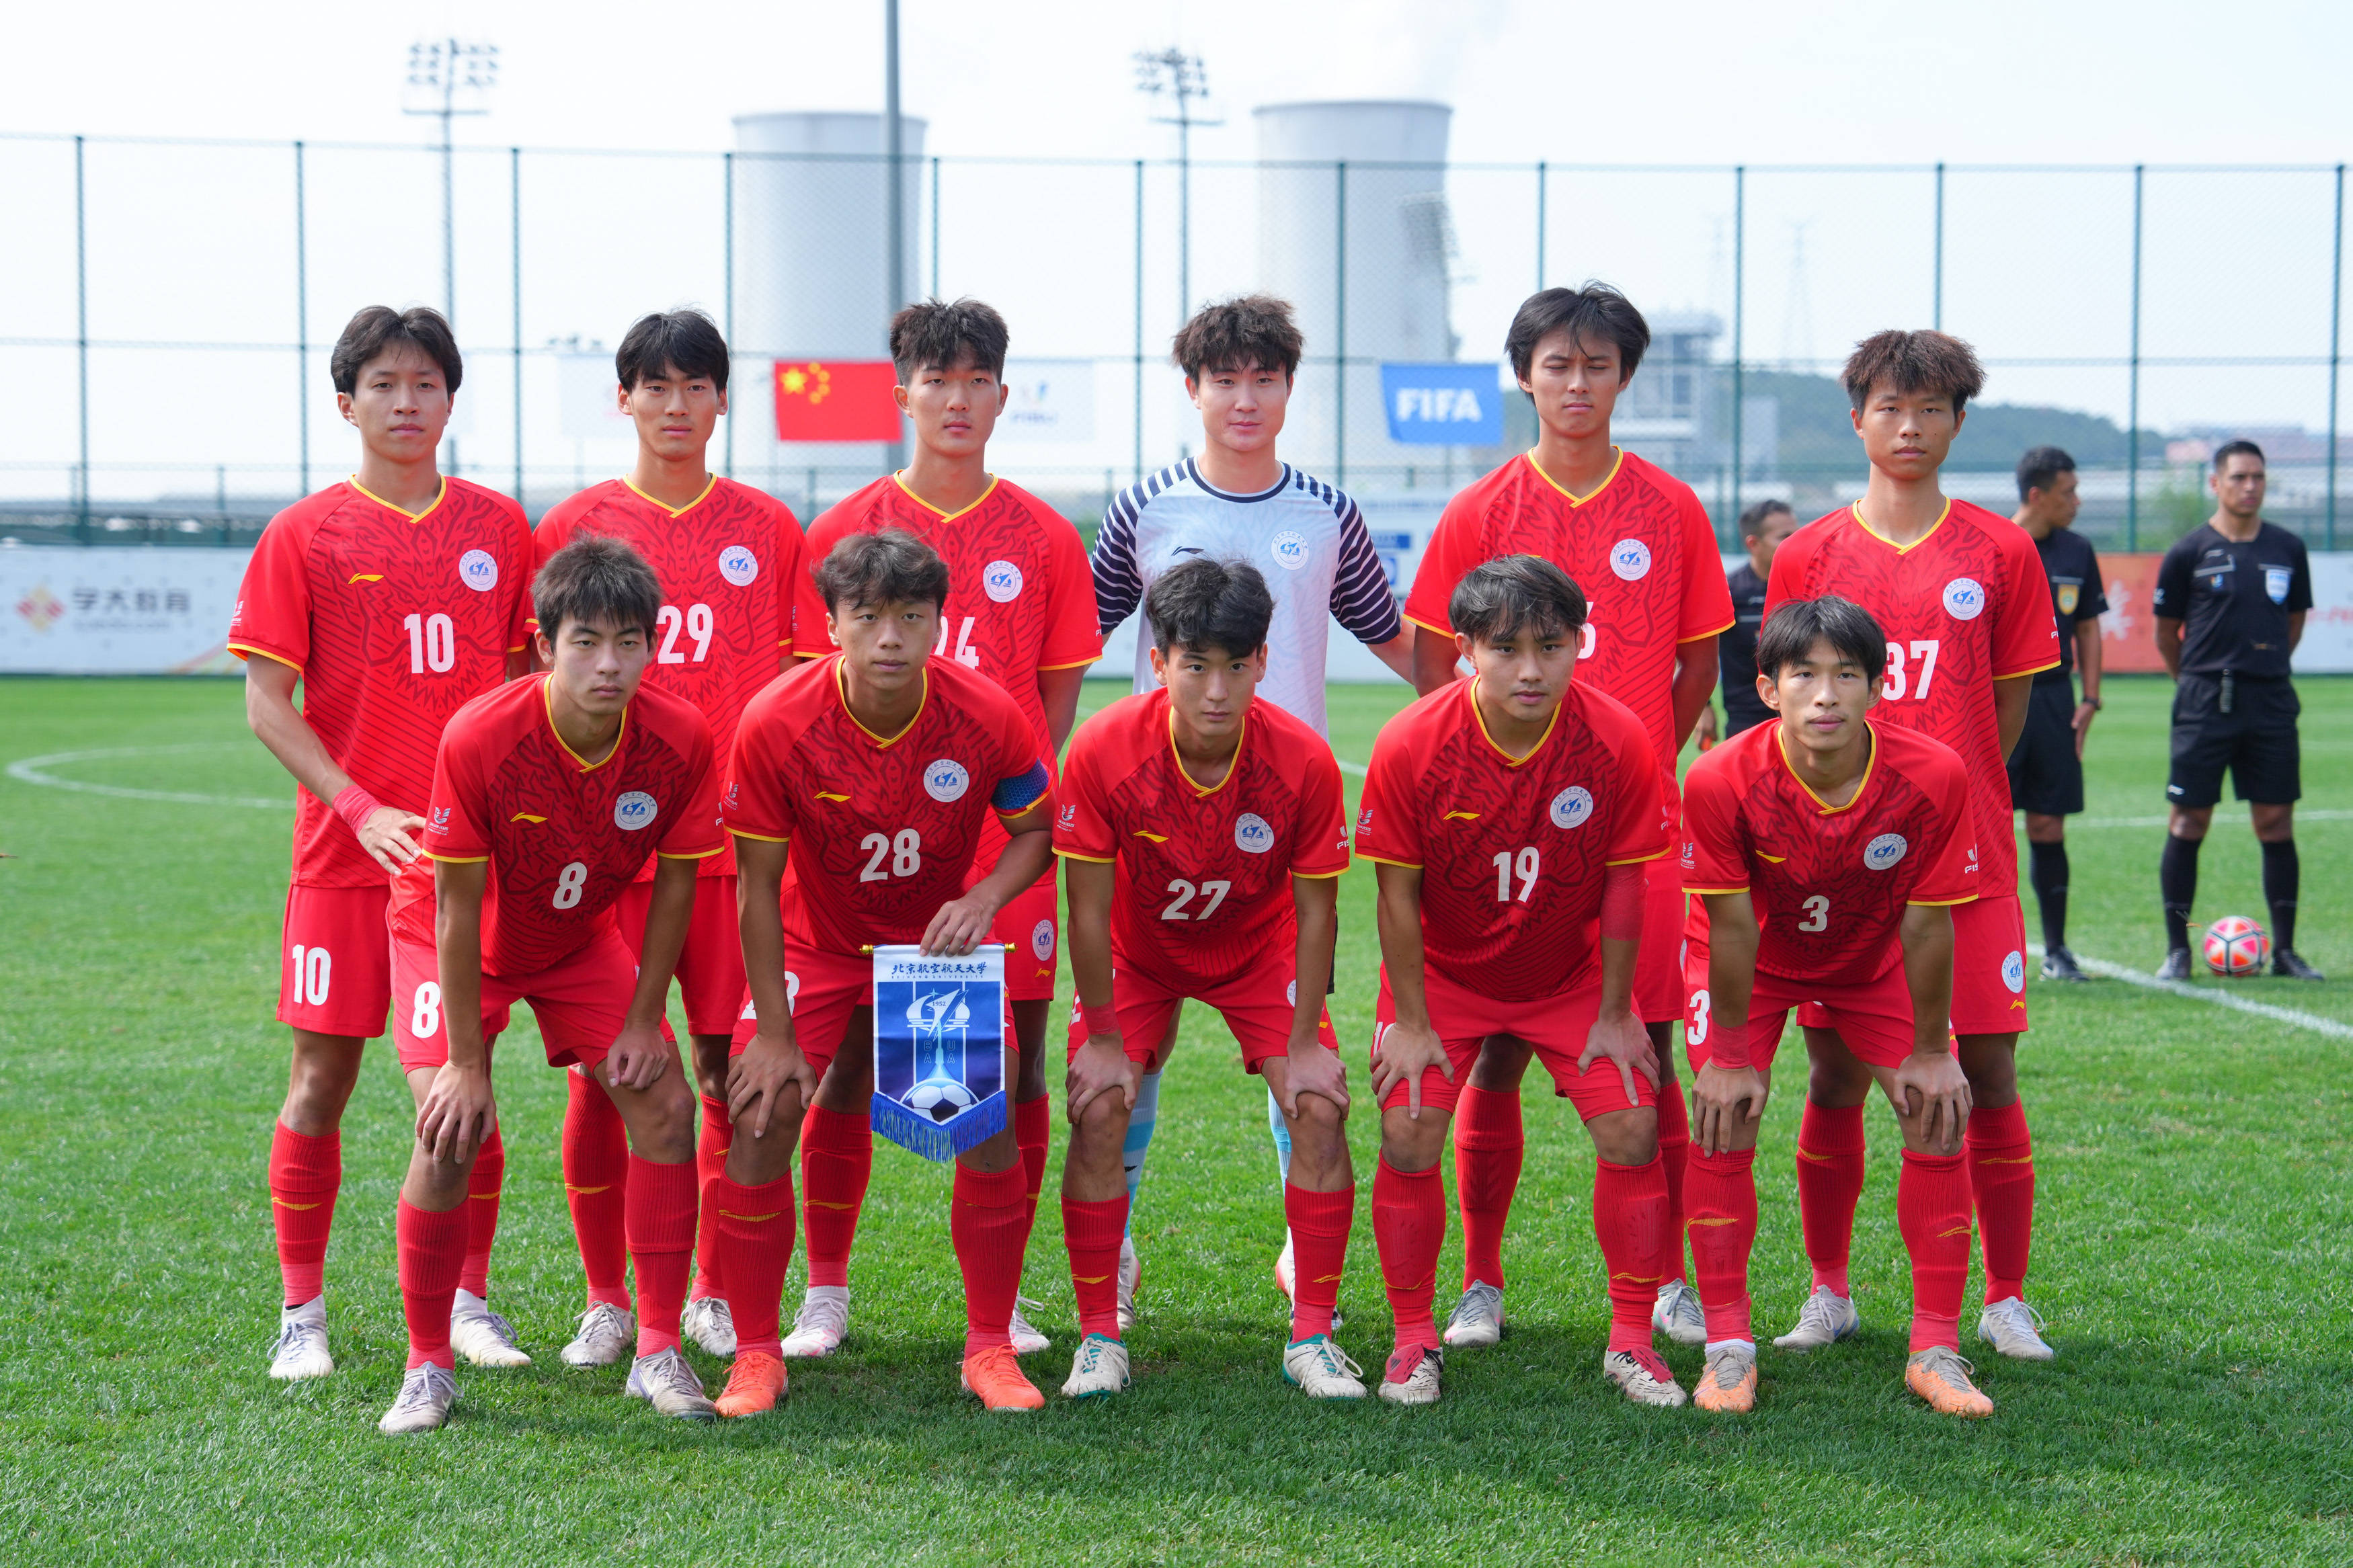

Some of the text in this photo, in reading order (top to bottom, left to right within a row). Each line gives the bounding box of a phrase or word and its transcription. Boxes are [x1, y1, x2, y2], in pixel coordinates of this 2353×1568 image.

[1395, 388, 1483, 423] FIFA
[404, 613, 455, 674] 10
[658, 603, 713, 664] 29
[1881, 639, 1940, 701] 37
[860, 828, 921, 882] 28
[1337, 839, 1350, 850] FIS
[1964, 861, 1979, 874] FIS
[552, 862, 588, 909] 8
[1161, 878, 1232, 921] 27
[1492, 846, 1540, 903] 19
[1798, 895, 1830, 932] 3
[292, 944, 331, 1006] 10
[411, 981, 441, 1039] 8
[1687, 989, 1710, 1046] 3
[924, 1053, 955, 1063] A A
[948, 1040, 955, 1050] U
